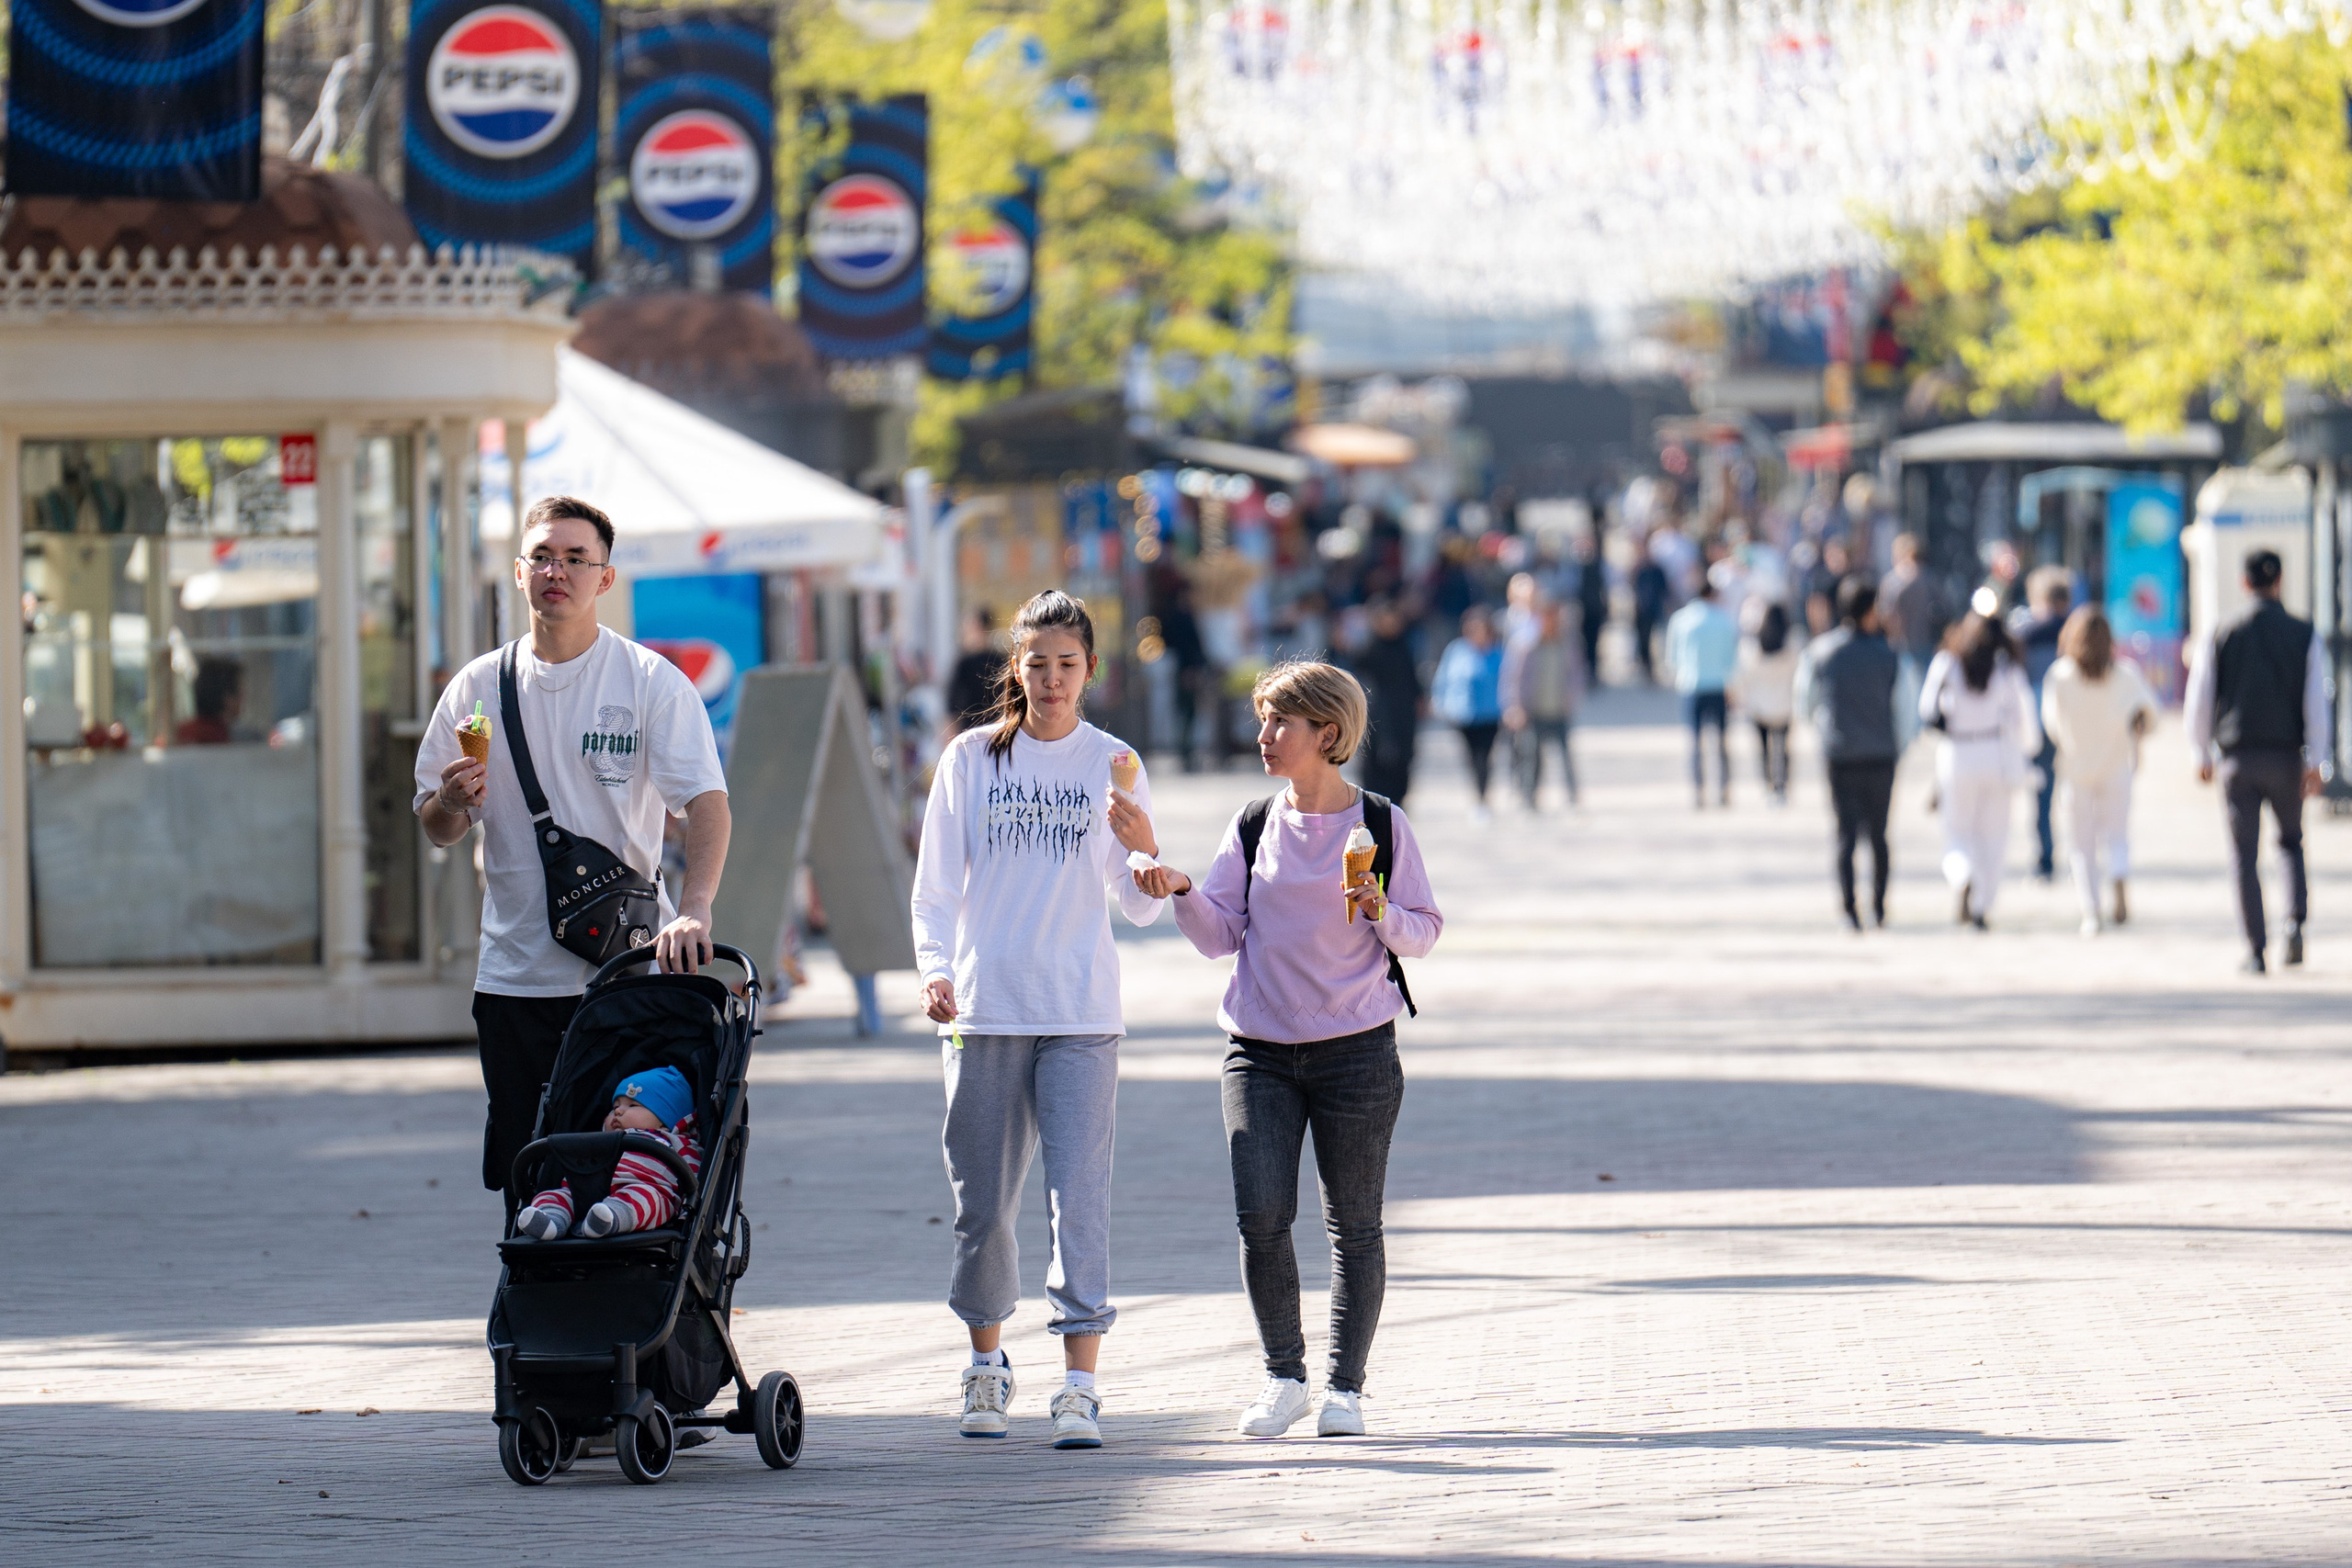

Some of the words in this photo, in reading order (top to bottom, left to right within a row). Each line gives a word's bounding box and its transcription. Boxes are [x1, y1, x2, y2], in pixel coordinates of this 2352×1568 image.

[444, 64, 565, 96] PEPSI
[283, 442, 314, 478] 22
[582, 728, 639, 759] paranoi
[557, 866, 626, 908] MONCLER
